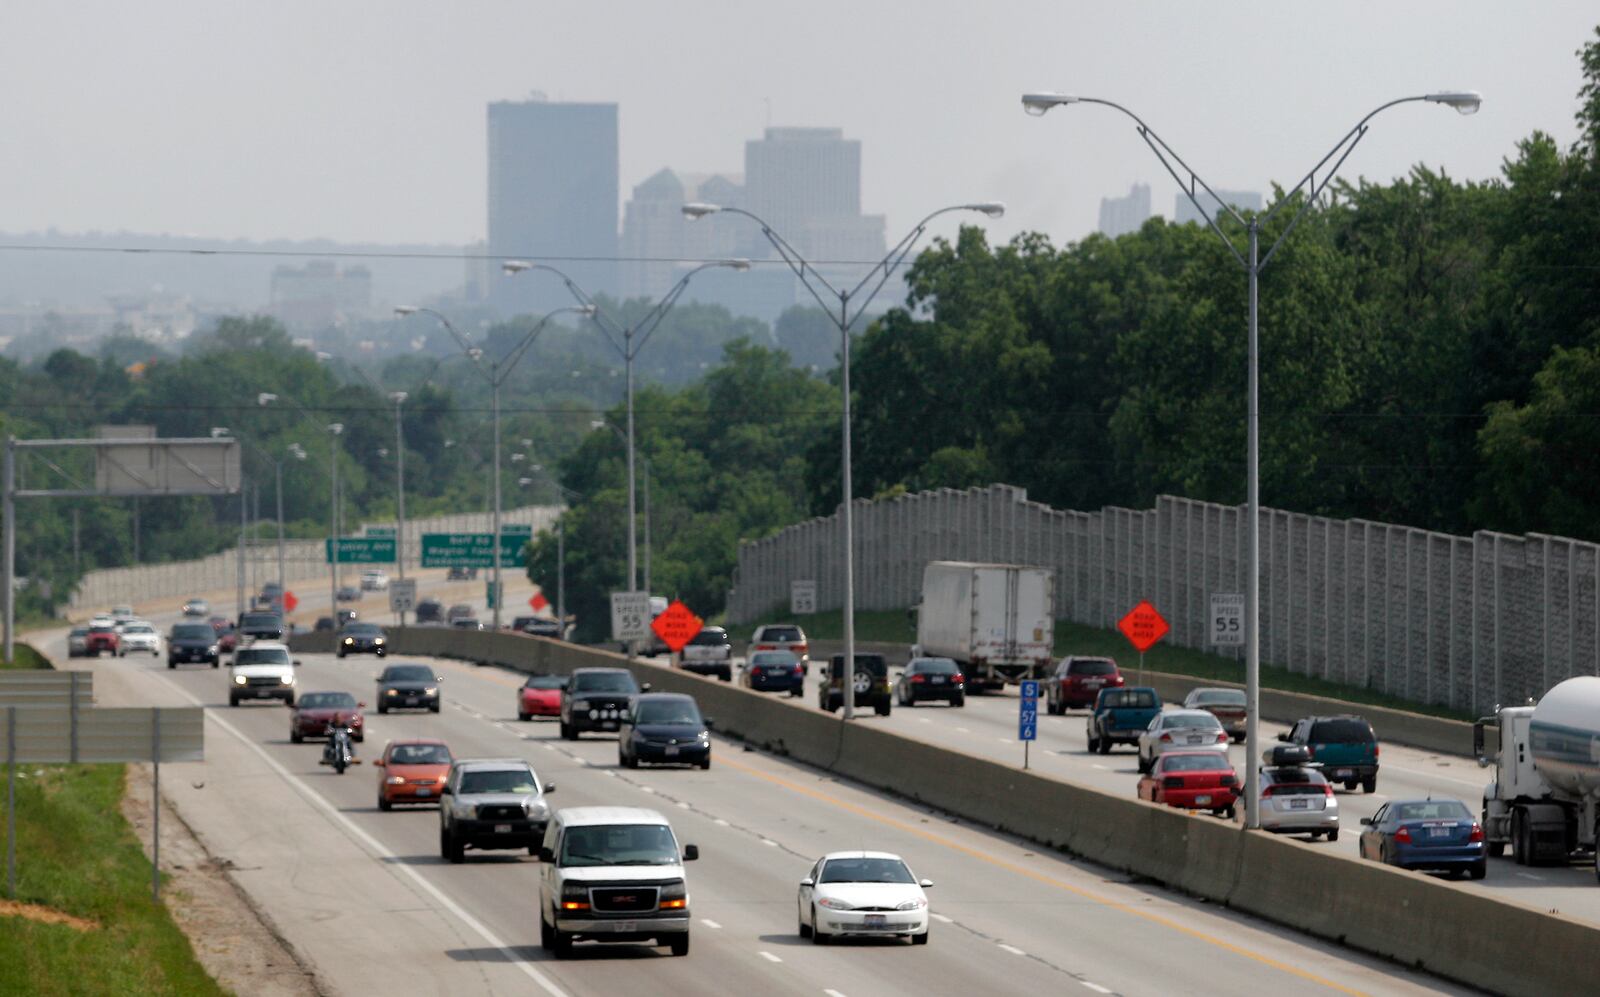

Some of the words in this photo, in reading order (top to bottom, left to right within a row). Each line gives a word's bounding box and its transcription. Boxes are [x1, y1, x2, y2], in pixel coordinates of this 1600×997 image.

[623, 615, 641, 629] 55
[1216, 617, 1240, 632] 55
[1025, 684, 1034, 697] S
[1023, 710, 1035, 723] 57
[1024, 726, 1032, 738] 6
